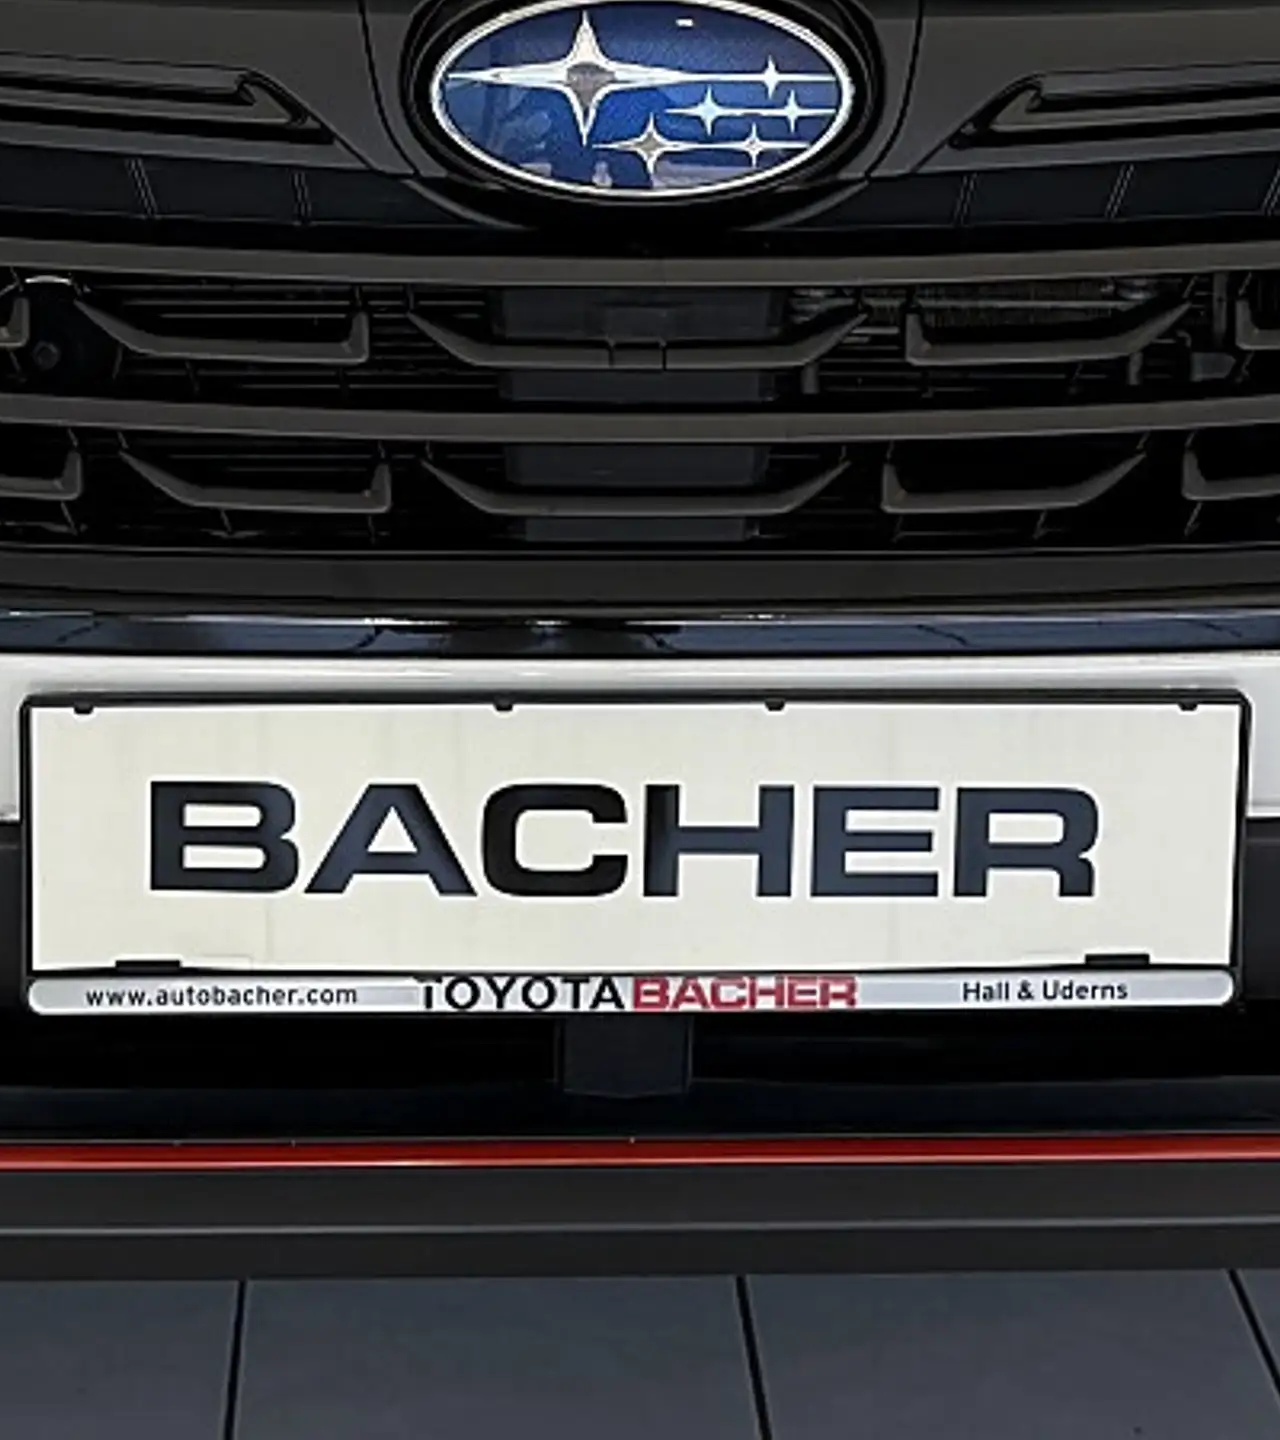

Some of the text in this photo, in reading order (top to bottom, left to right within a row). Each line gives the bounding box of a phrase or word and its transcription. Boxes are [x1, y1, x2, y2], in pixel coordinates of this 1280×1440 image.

[149, 781, 1100, 898] BACHER
[85, 985, 359, 1009] www.autobacher.com
[632, 976, 858, 1011] BACHER
[962, 978, 1130, 1002] Hall & Uderns
